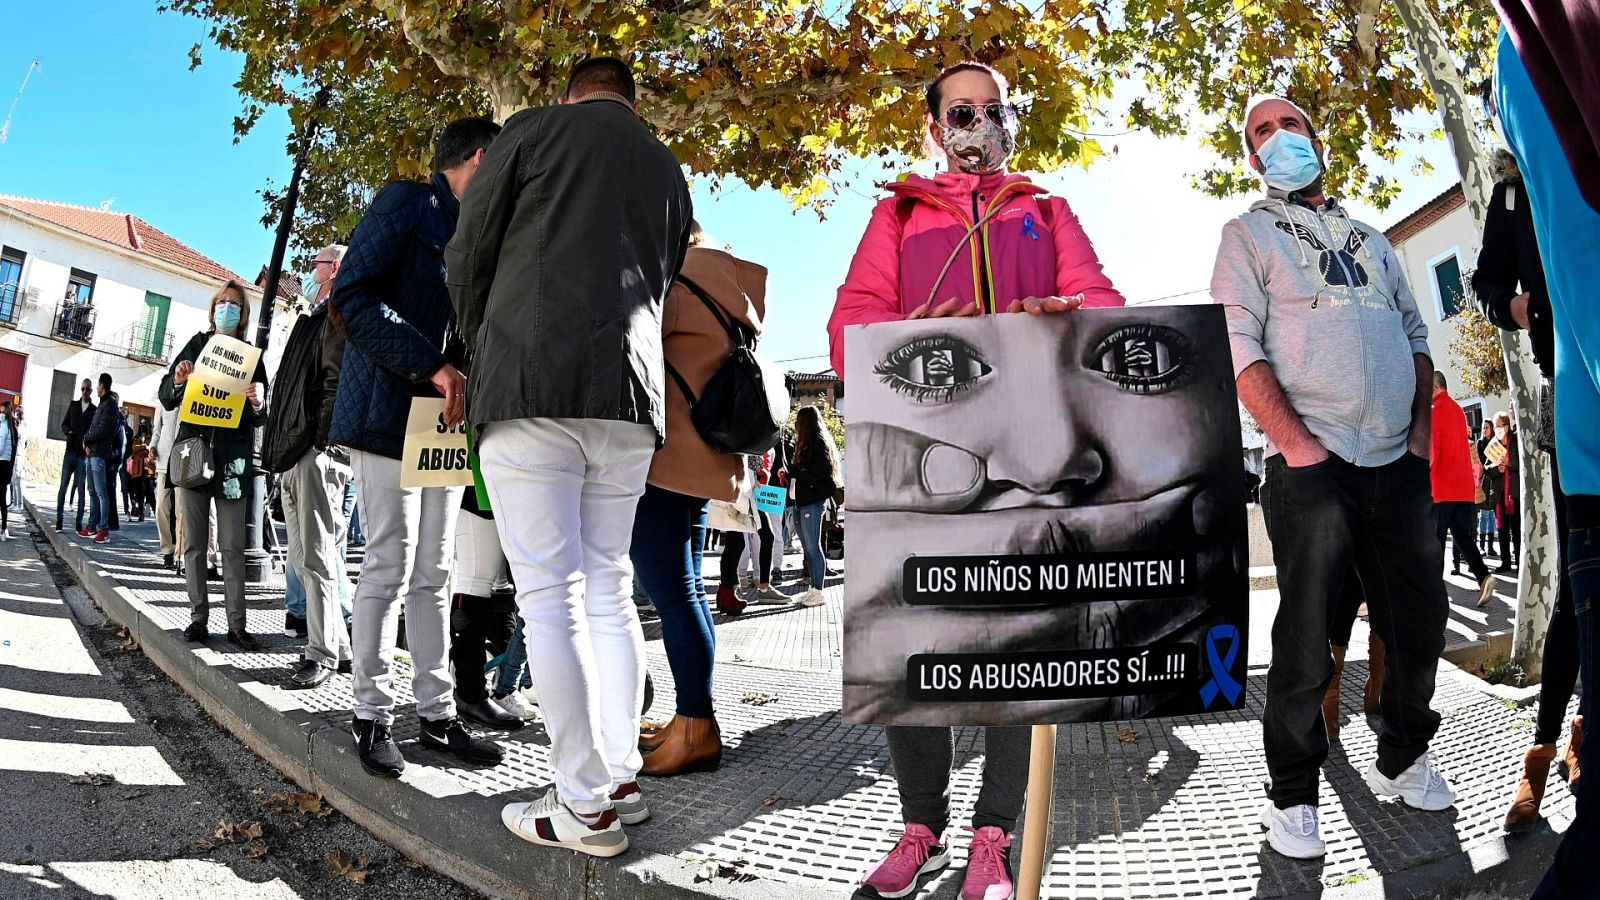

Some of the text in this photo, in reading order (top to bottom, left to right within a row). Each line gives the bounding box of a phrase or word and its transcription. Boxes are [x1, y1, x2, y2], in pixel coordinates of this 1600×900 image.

[212, 345, 244, 365] LOS NIÑOS
[201, 356, 209, 365] NO
[209, 360, 218, 370] SE
[219, 363, 240, 378] TOCAN
[202, 383, 230, 400] STOP
[190, 401, 233, 420] ABUSOS
[916, 559, 1185, 593] LOS NIÑOS NO MIENTEN !
[920, 664, 962, 690] LOS
[969, 659, 1120, 690] ABUSADORES
